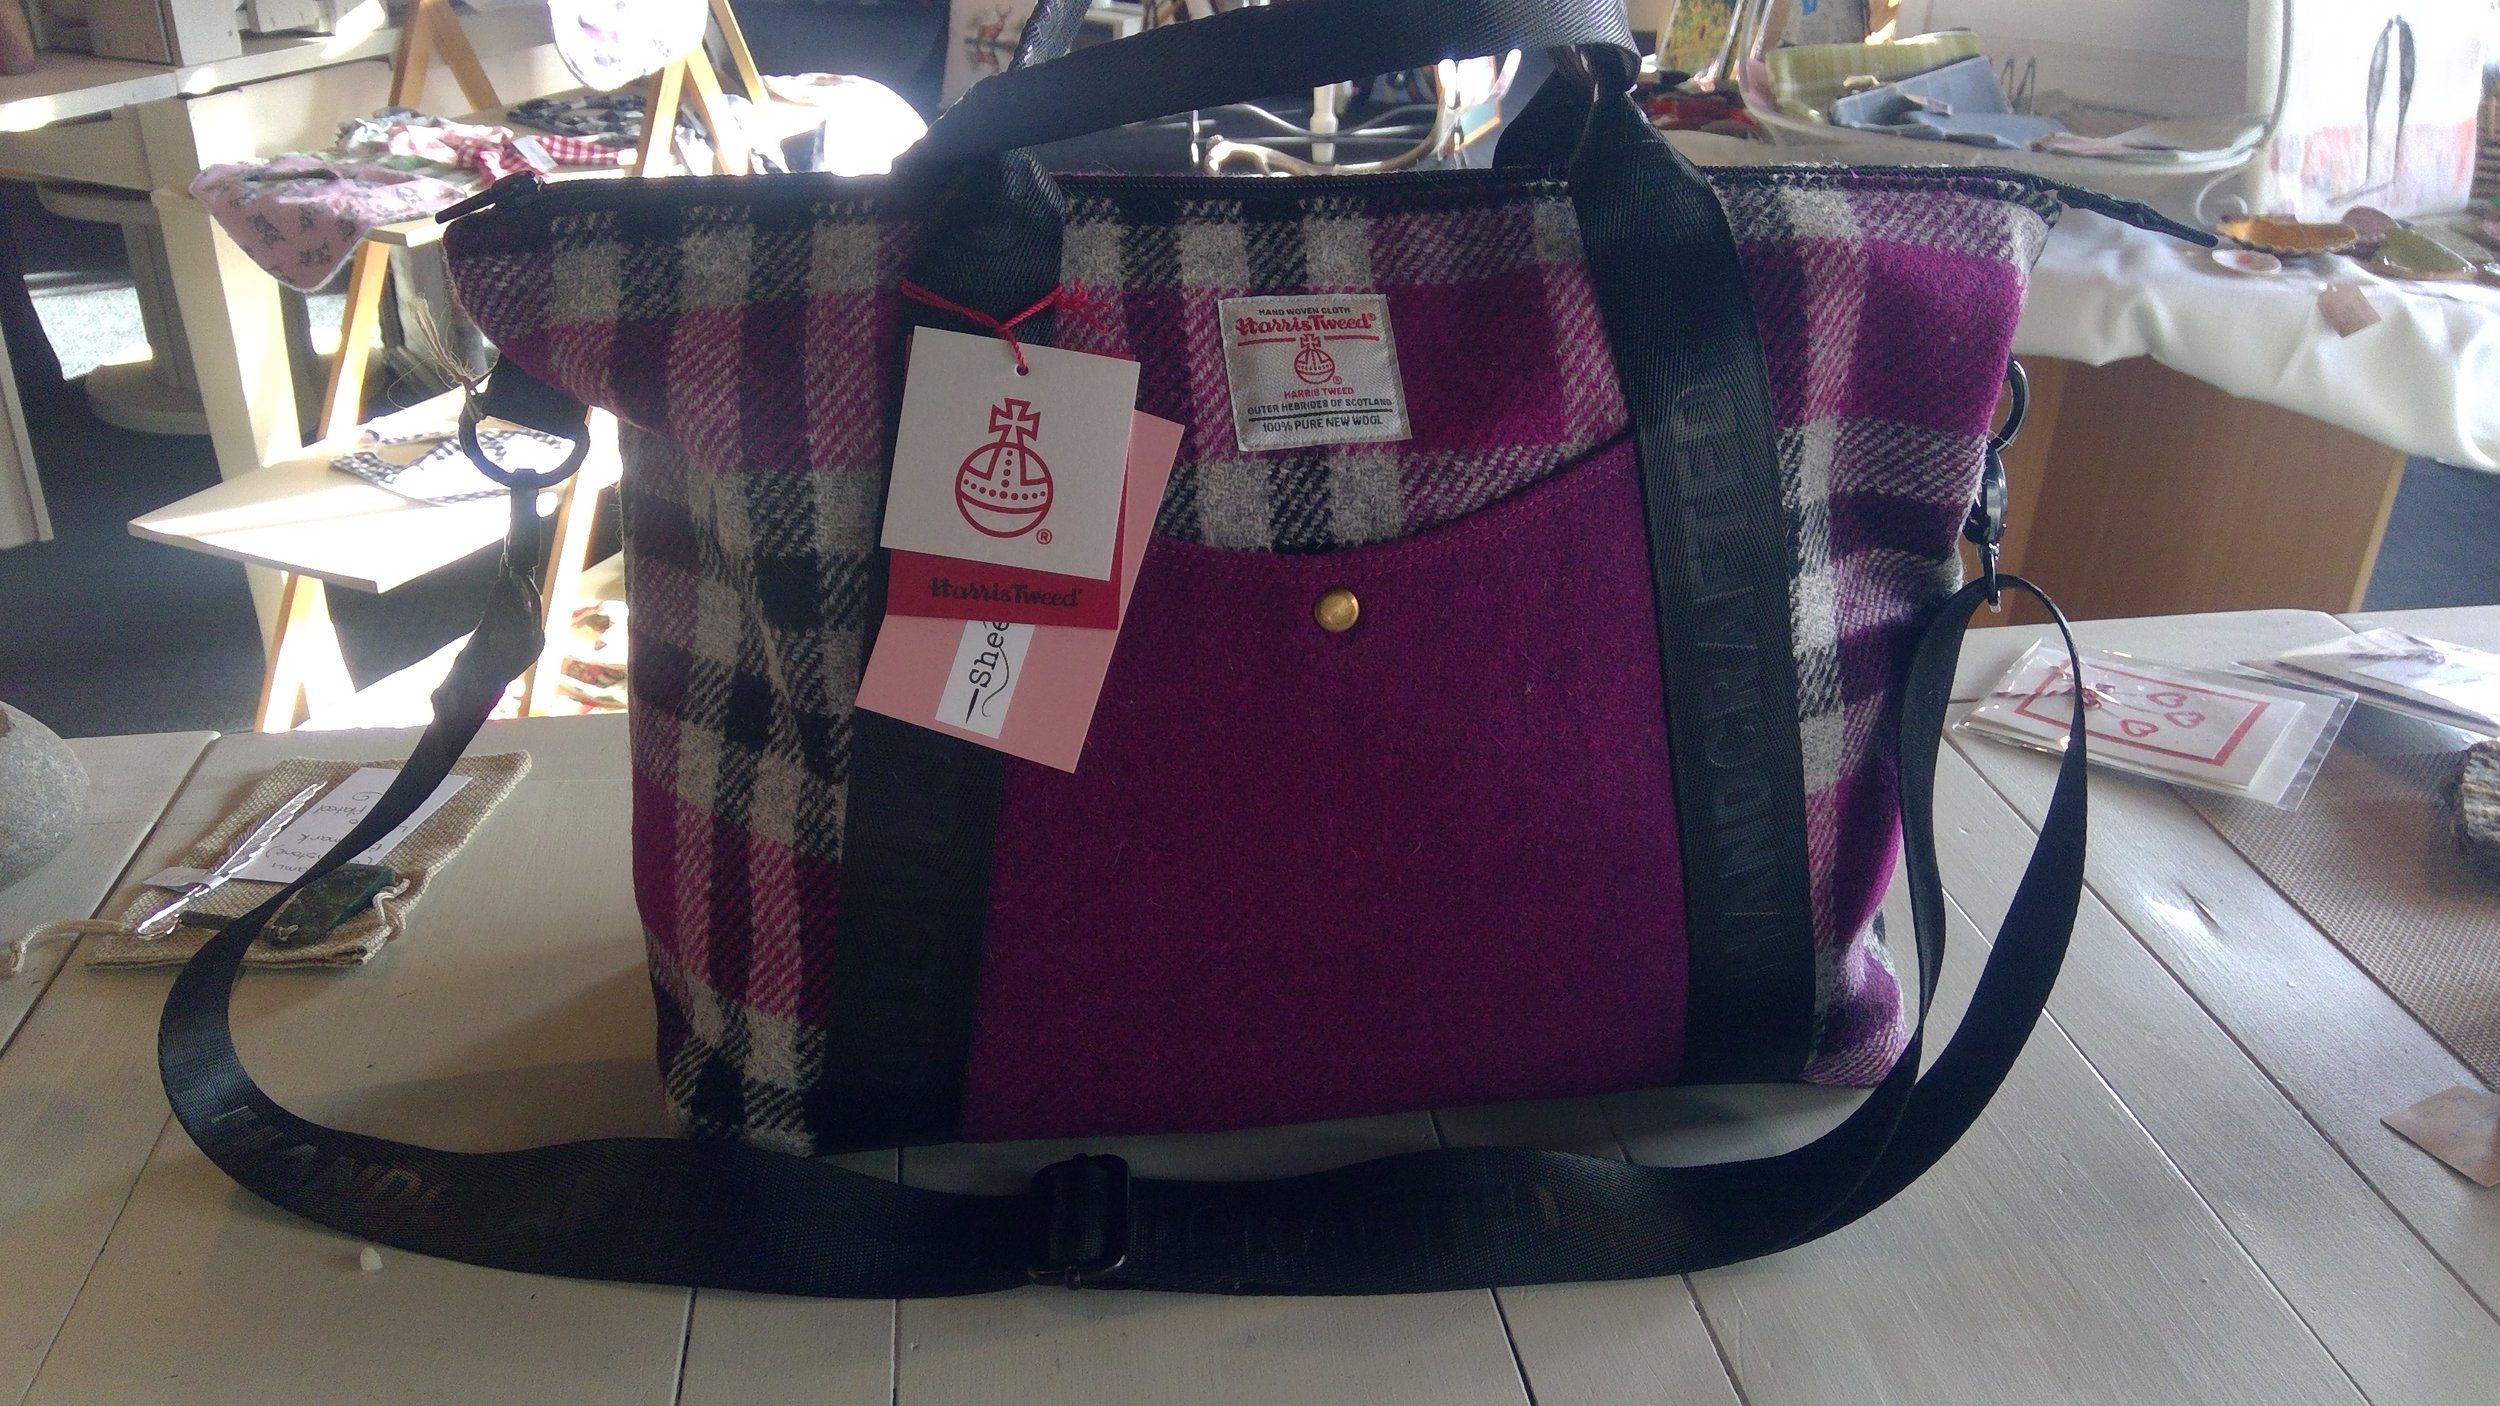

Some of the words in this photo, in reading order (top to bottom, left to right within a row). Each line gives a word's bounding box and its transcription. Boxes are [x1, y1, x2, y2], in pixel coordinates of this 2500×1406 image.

[1258, 308, 1285, 316] HAND
[1285, 307, 1319, 315] WOVEN
[1321, 306, 1351, 315] CLOTH
[1284, 388, 1320, 400] HARRIS
[1322, 386, 1355, 397] TWEED
[1247, 404, 1280, 416] OUTER
[1281, 400, 1329, 413] HEBRIDES
[1330, 398, 1345, 408] OF
[1345, 398, 1393, 408] SCOTLAND
[1262, 420, 1294, 433] 100%
[1295, 418, 1324, 431] PURE
[1325, 416, 1351, 428] NEW
[1351, 414, 1384, 426] WOOL
